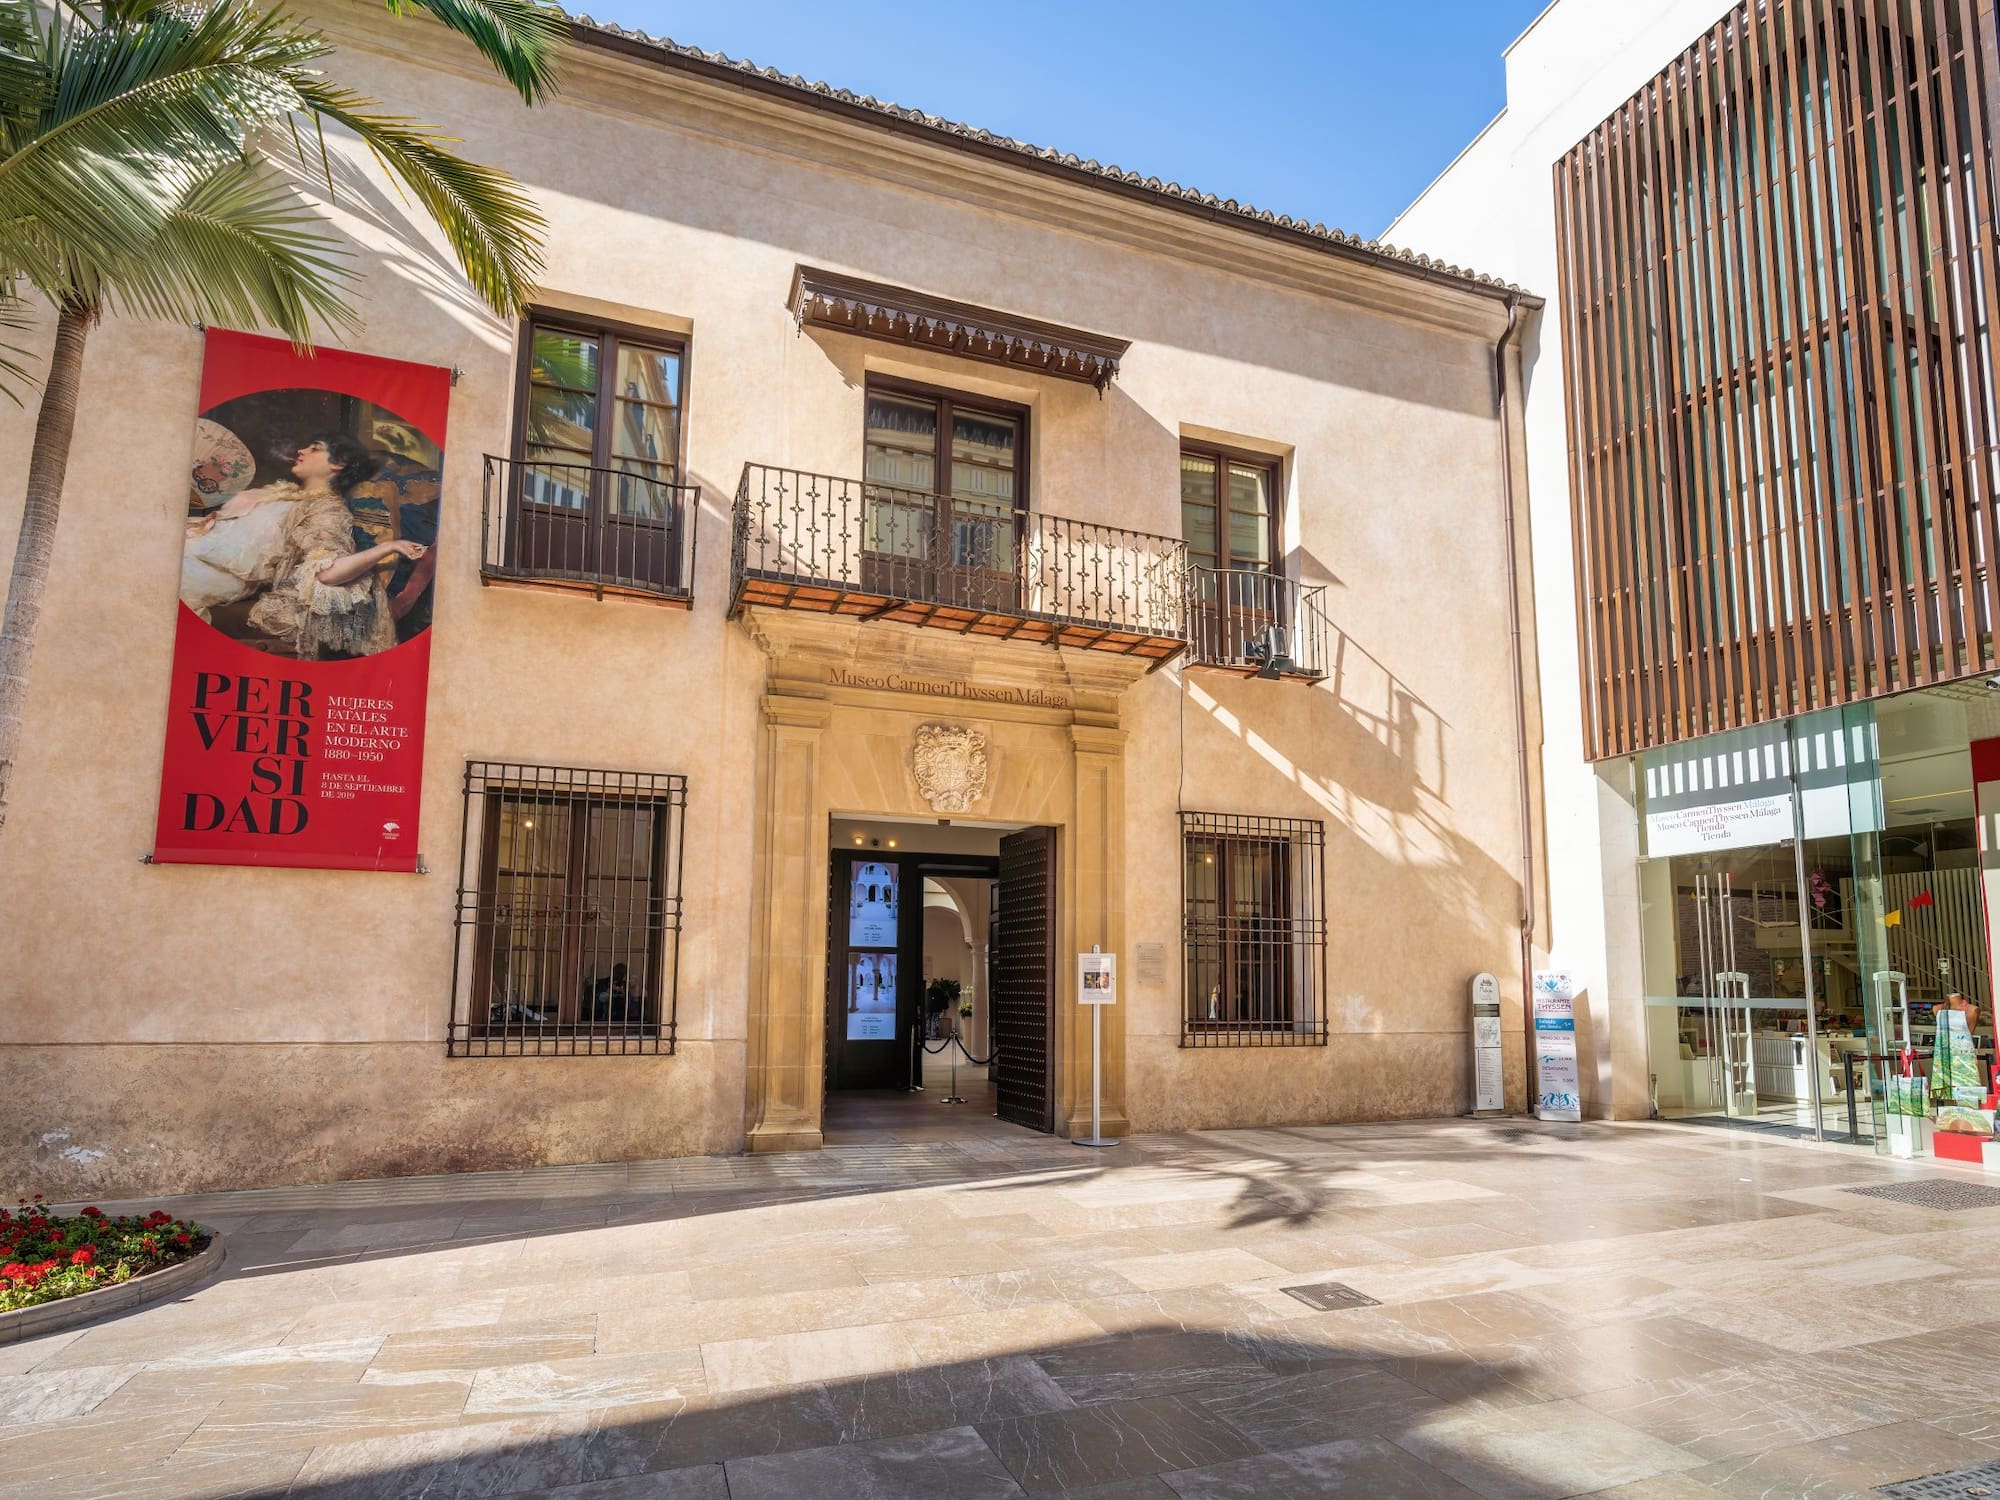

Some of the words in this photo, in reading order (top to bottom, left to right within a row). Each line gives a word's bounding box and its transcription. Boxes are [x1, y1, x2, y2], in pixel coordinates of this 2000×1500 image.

[189, 672, 315, 718] PER
[829, 667, 885, 688] Museo
[1015, 687, 1069, 709] Málaga
[327, 695, 394, 711] MUJERES
[326, 708, 387, 723] FATALES
[187, 711, 313, 757] VER
[326, 722, 346, 733] EN
[349, 723, 367, 735] EL
[369, 726, 409, 738] ARTE
[325, 735, 401, 750] MODERNO
[251, 756, 312, 796] SI
[322, 772, 355, 782] HASTA
[356, 774, 370, 783] EL
[320, 781, 328, 789] 8
[328, 782, 343, 790] DE
[343, 783, 406, 793] SEPTIEMBRE
[320, 790, 335, 799] DE
[336, 791, 356, 800] 2019
[179, 792, 309, 835] DAD
[1657, 821, 1683, 832] Museo
[1749, 806, 1782, 819] Málaga
[1695, 822, 1725, 833] Tienda
[1701, 830, 1731, 841] Tienda
